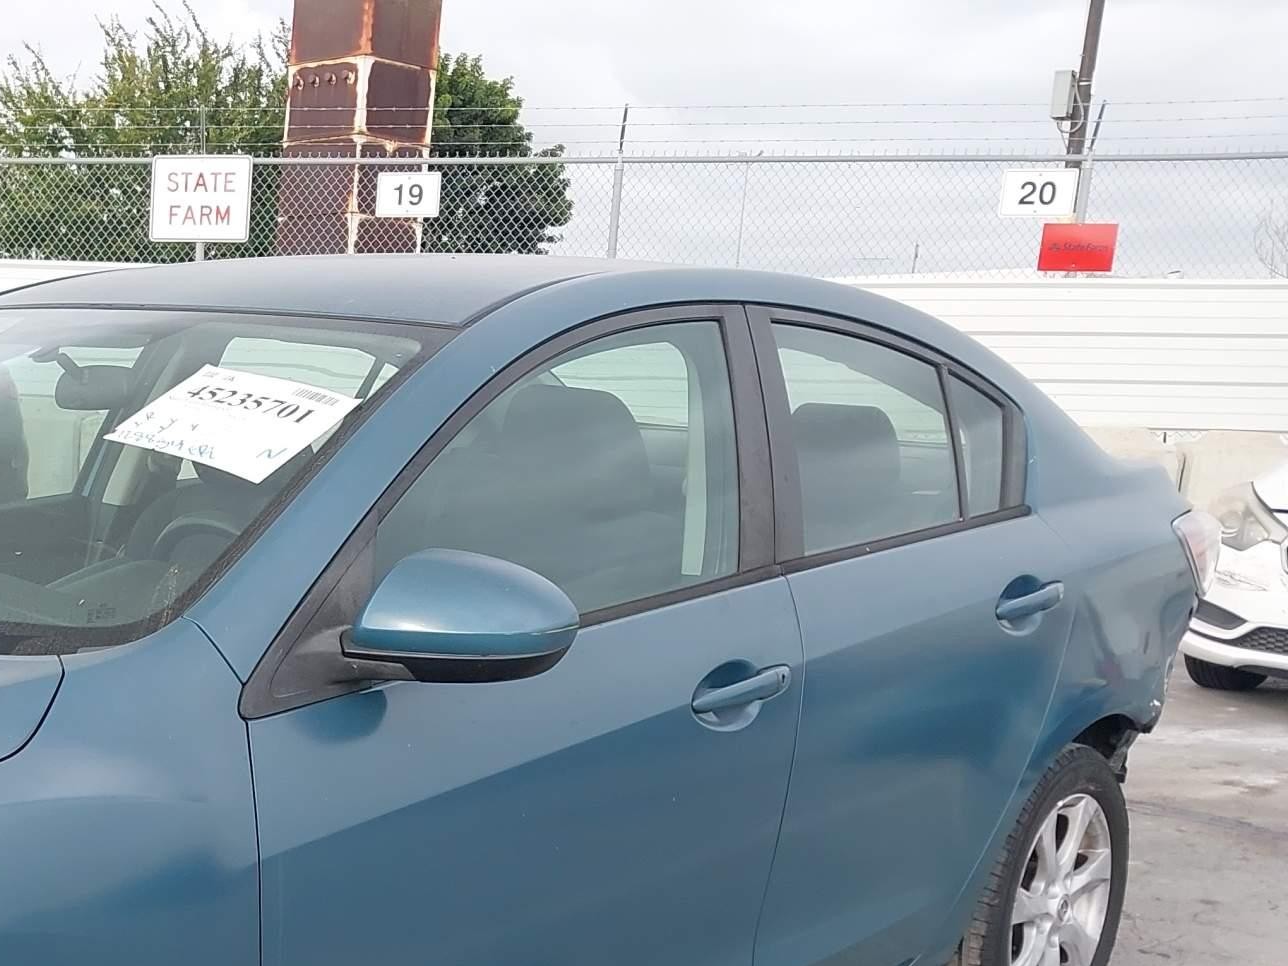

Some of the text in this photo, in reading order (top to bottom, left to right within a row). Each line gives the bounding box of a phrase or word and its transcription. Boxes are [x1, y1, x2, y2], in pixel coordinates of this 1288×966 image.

[167, 171, 236, 193] STATE
[1018, 181, 1057, 206] 20
[393, 183, 424, 206] 19
[168, 204, 231, 226] FARM
[187, 384, 316, 424] 45235701
